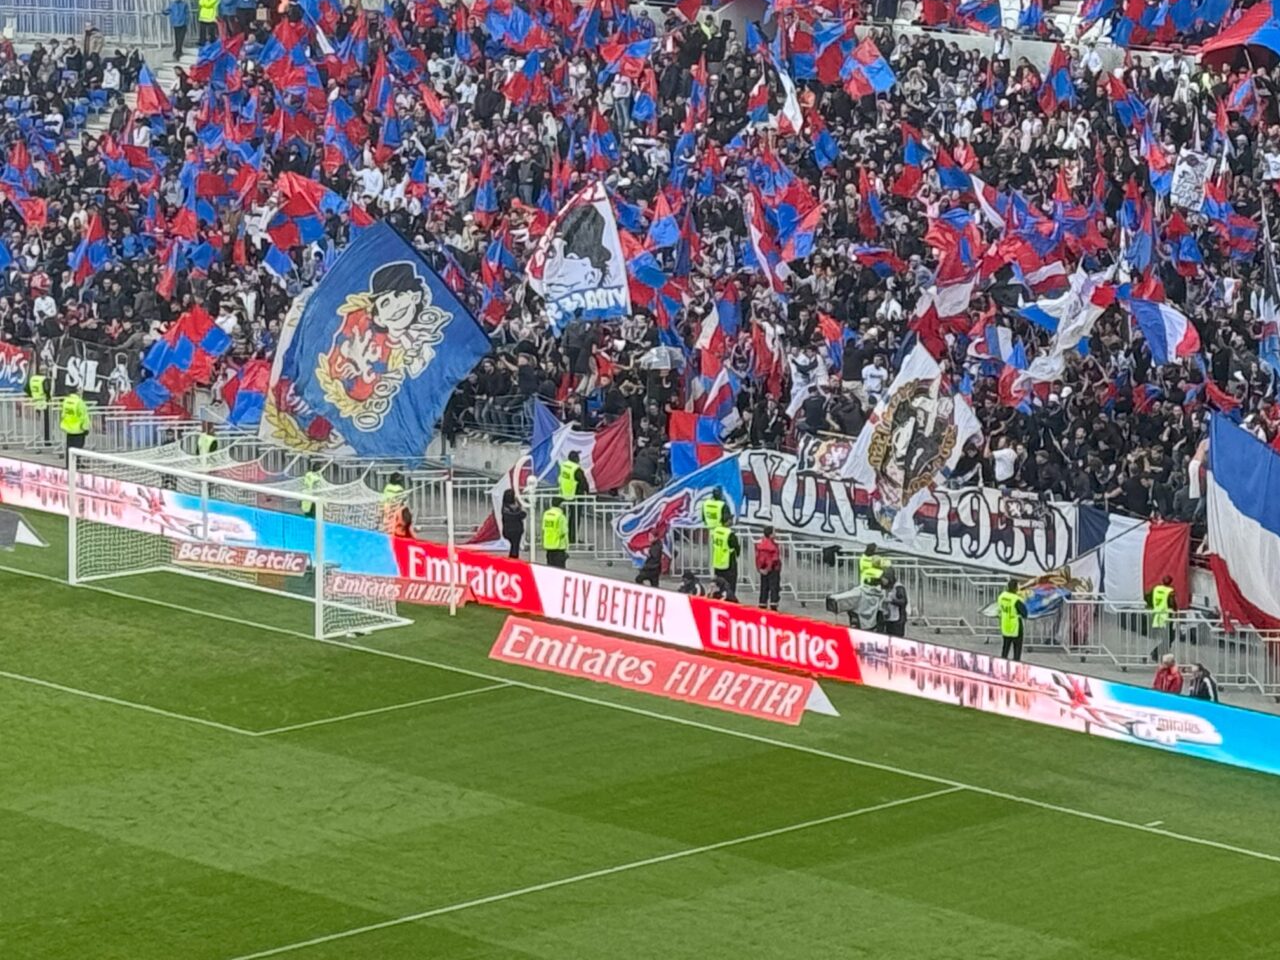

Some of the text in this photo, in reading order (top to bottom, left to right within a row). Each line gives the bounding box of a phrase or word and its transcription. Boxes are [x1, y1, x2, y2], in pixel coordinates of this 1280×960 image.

[740, 452, 858, 537] YON
[931, 489, 1072, 573] 1950
[178, 542, 304, 571] Betclic Betclic
[408, 545, 523, 604] Emirates
[562, 575, 666, 635] FLY BETTER
[710, 607, 840, 670] Emirates
[502, 625, 804, 718] Emirates FLY BETTER
